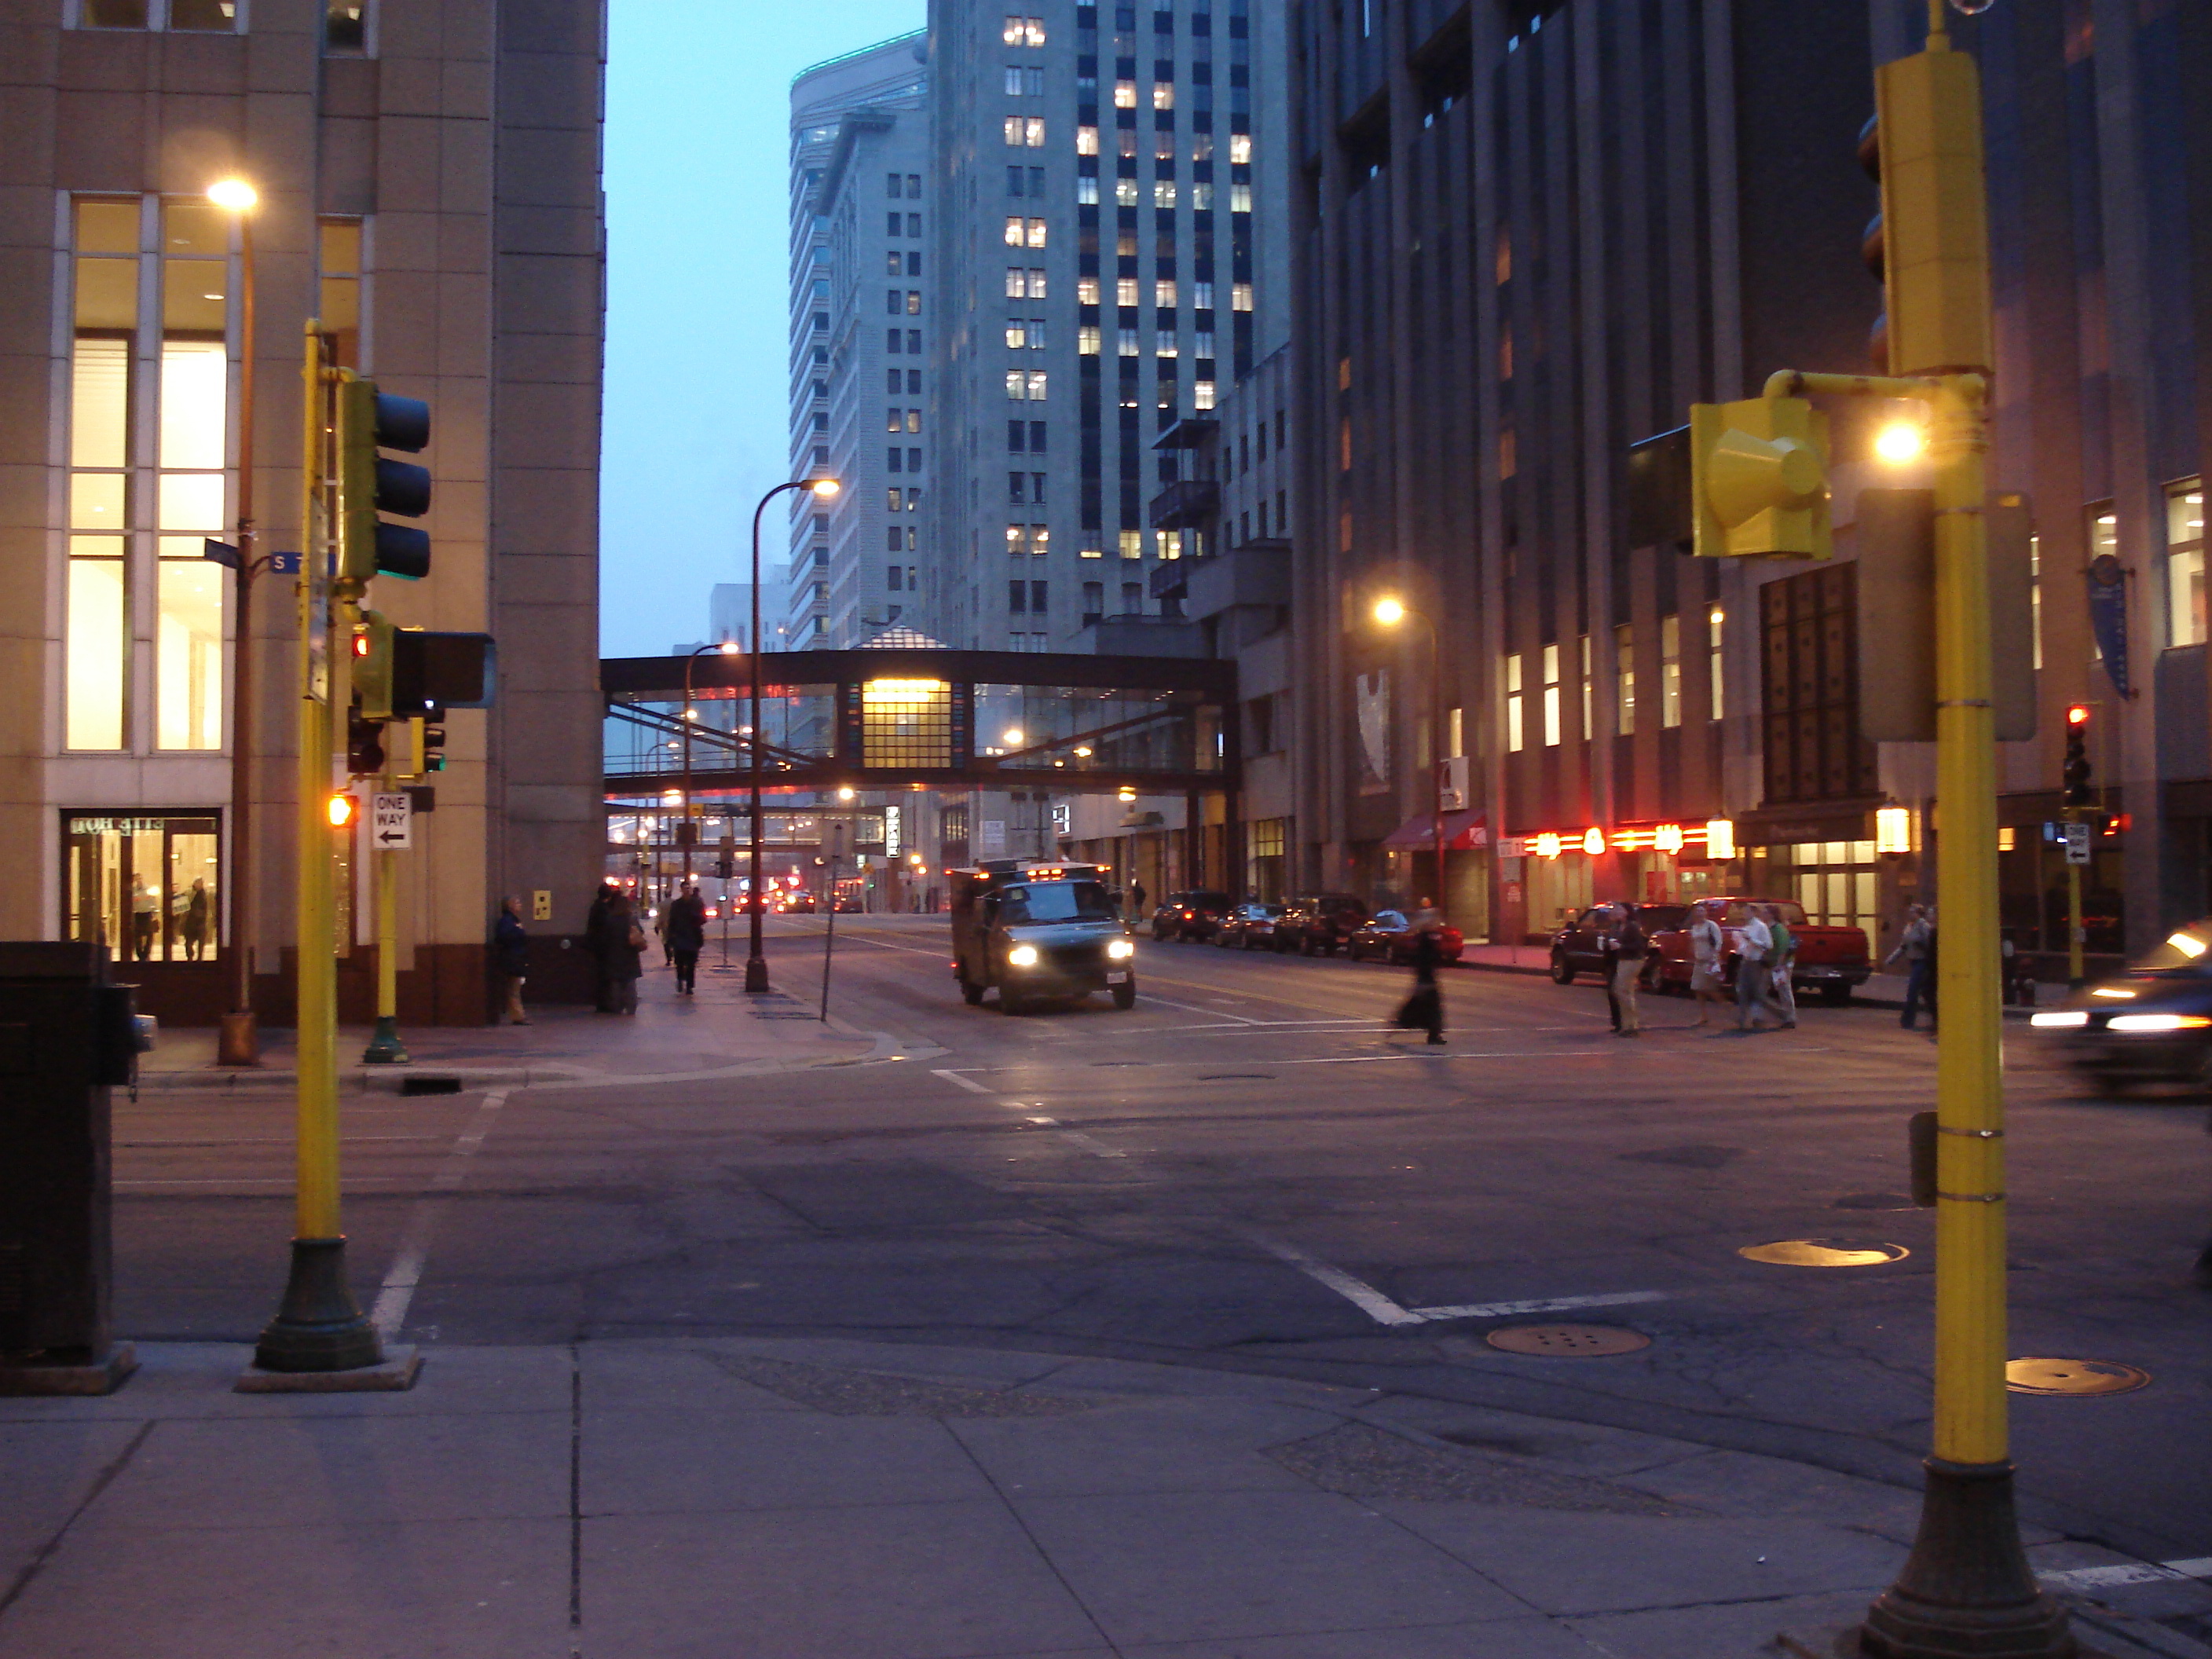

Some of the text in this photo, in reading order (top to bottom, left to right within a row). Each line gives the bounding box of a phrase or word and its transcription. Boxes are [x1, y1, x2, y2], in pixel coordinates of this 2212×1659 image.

[274, 555, 285, 569] S
[378, 796, 405, 810] ONE
[377, 813, 406, 826] WAY
